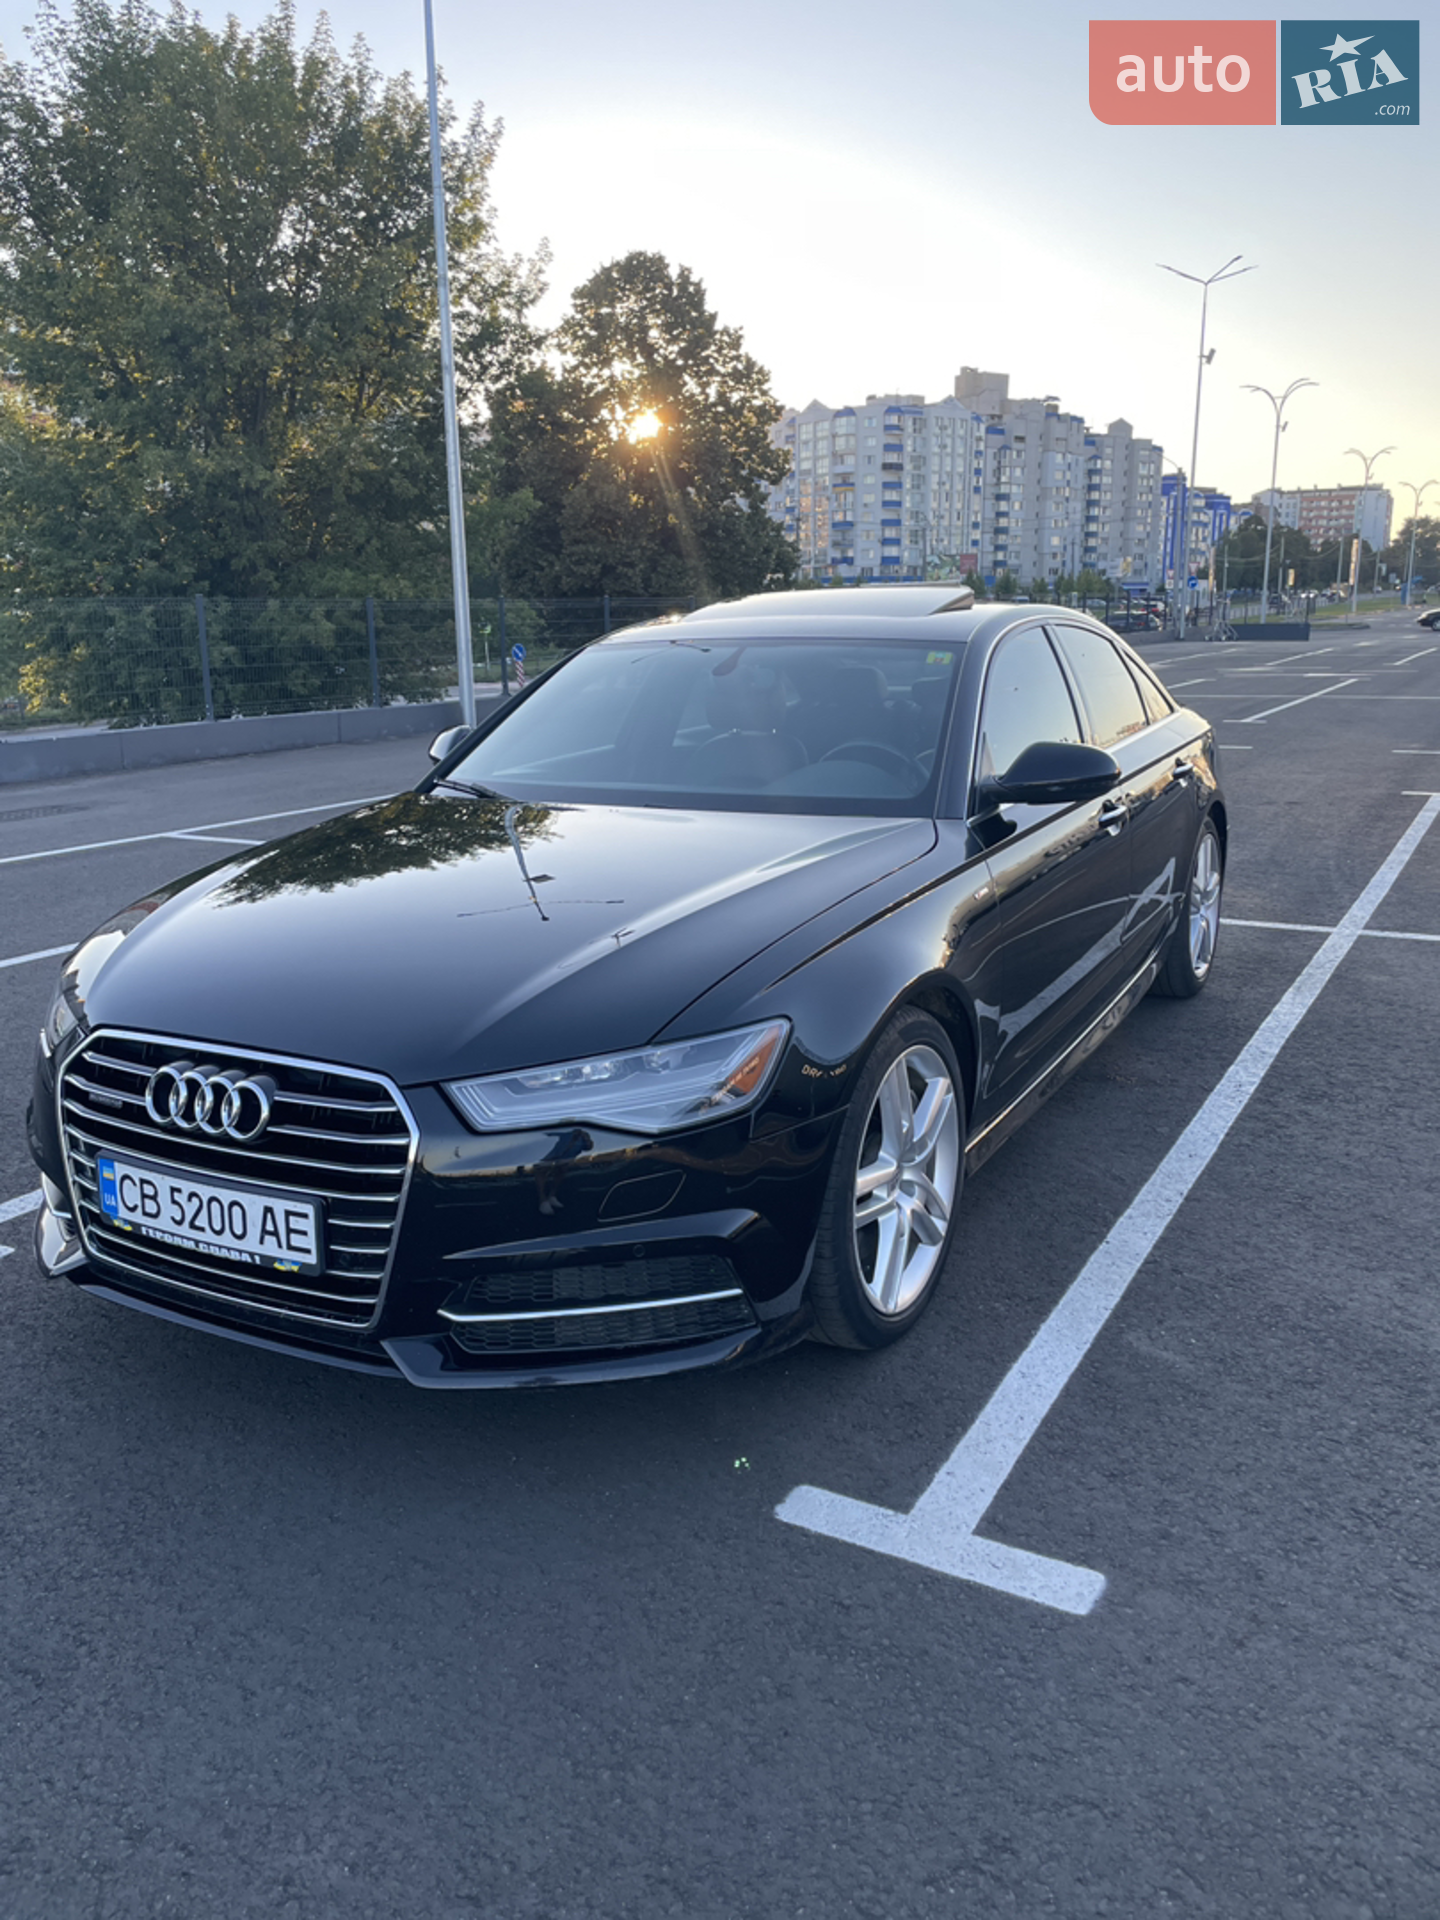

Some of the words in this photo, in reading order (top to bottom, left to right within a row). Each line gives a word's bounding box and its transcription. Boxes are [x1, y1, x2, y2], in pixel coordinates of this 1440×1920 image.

[104, 1193, 117, 1208] UA
[118, 1173, 161, 1220] CB
[169, 1185, 248, 1241] 5200
[259, 1205, 312, 1255] AE
